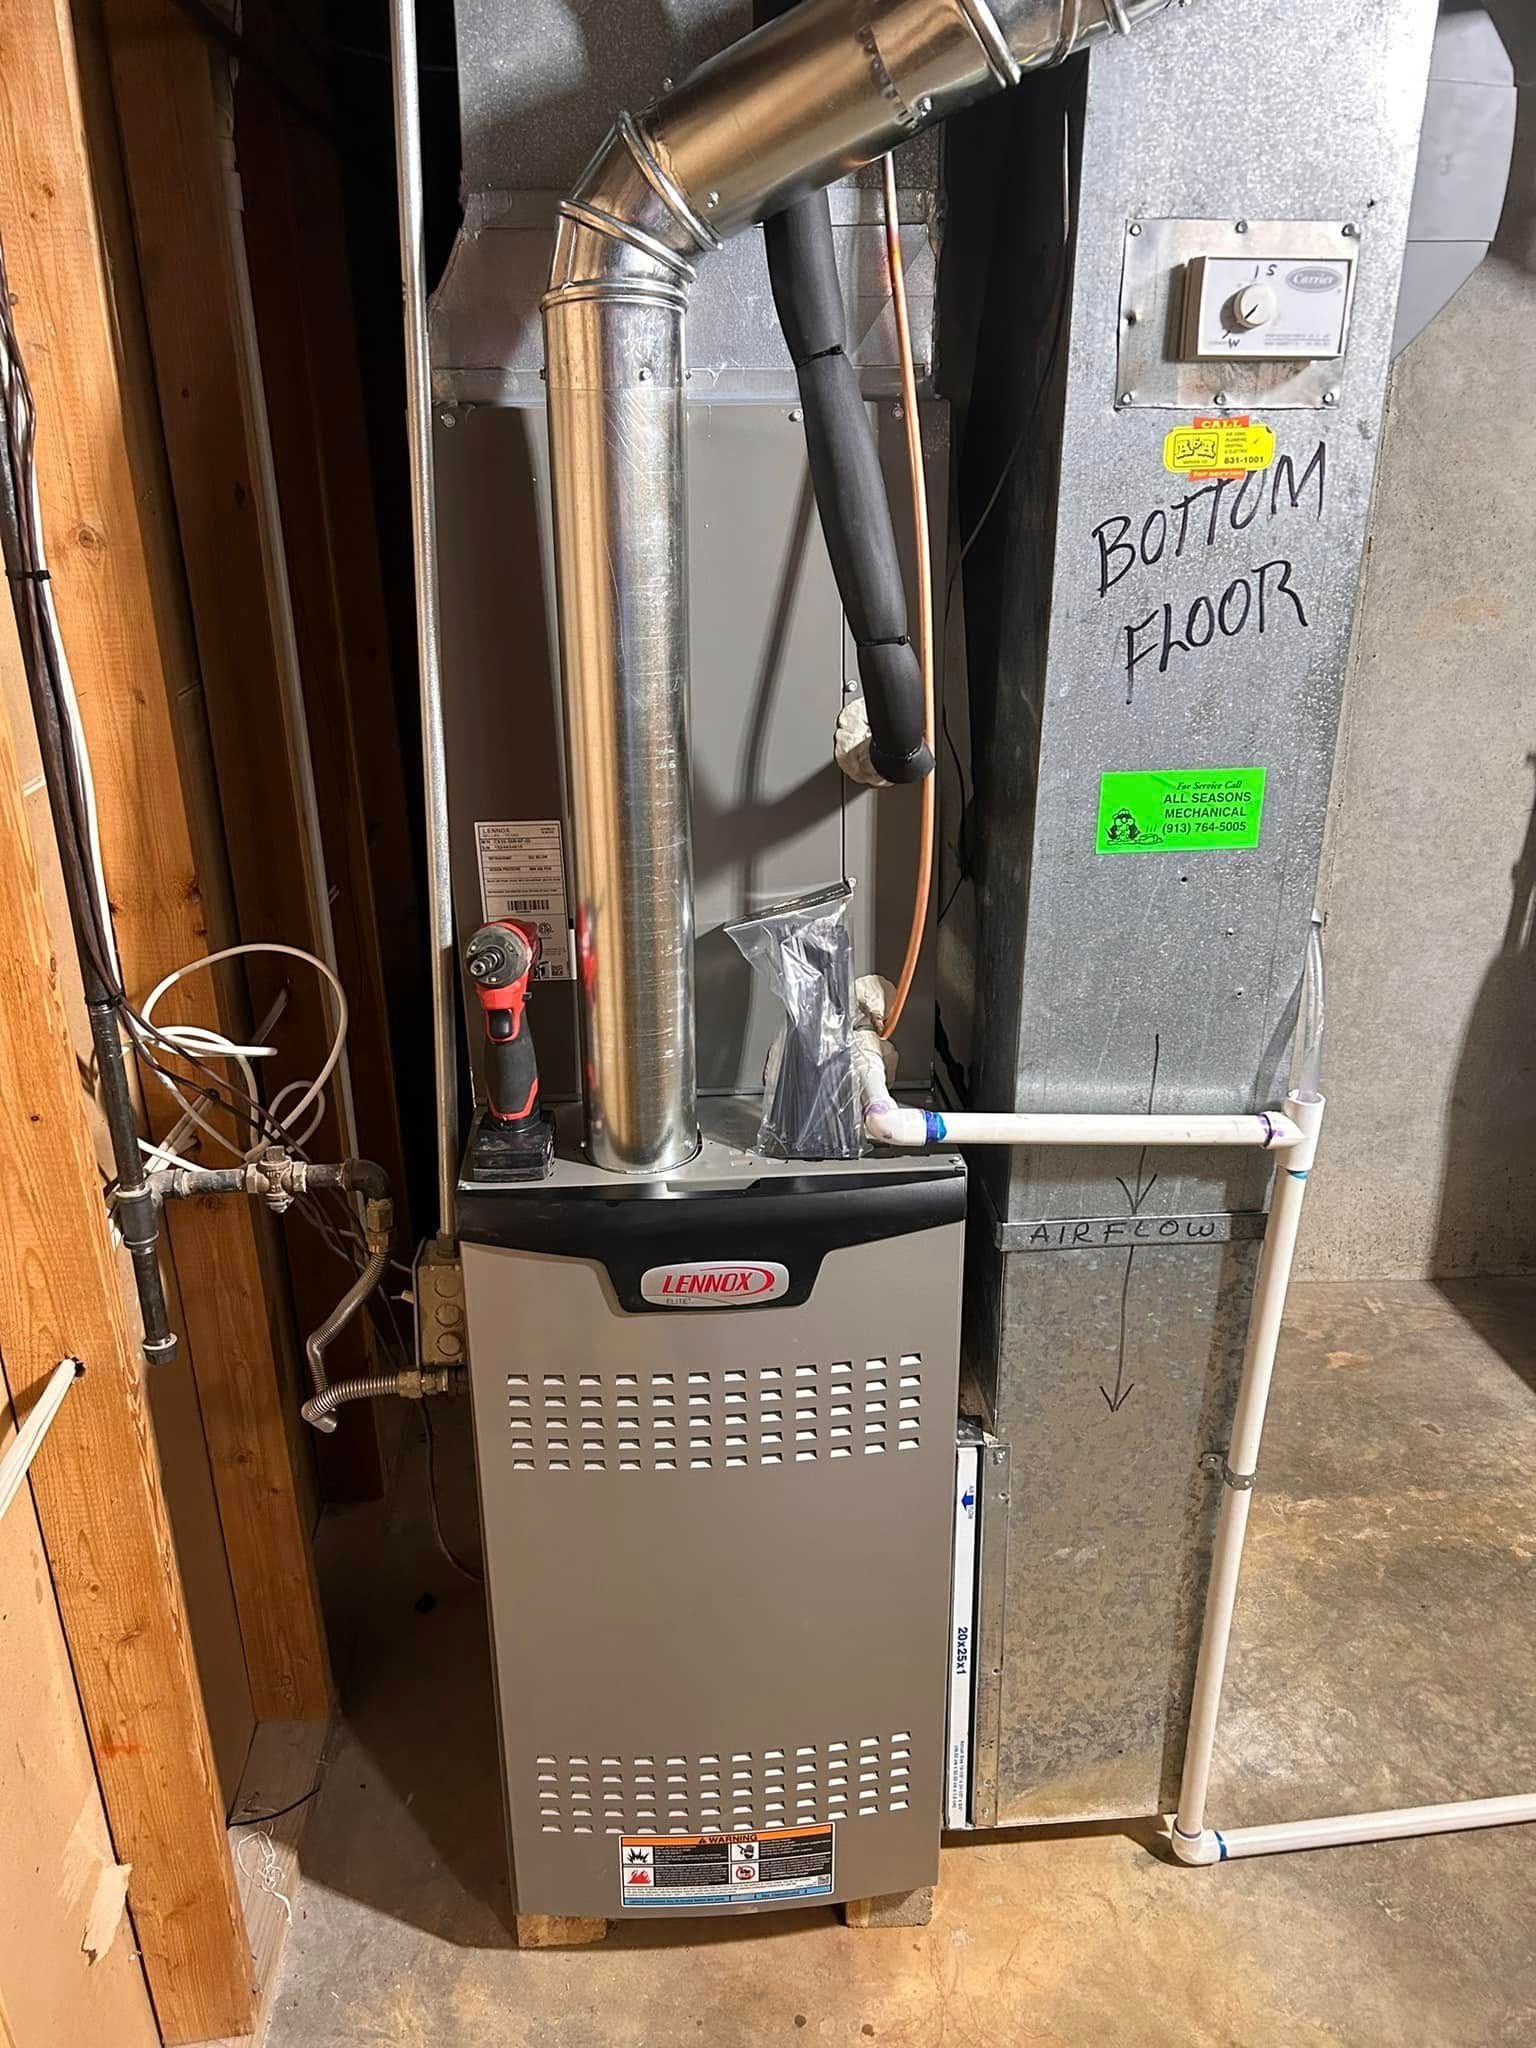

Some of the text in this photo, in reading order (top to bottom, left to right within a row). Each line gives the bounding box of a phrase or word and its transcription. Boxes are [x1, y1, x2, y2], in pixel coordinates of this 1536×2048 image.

[1201, 419, 1242, 429] CALL
[1224, 456, 1264, 465] 831-1001
[1091, 440, 1327, 599] BOTTOM
[1123, 559, 1309, 706] FLOOR
[1176, 780, 1243, 791] For Service Call
[1163, 791, 1252, 804] ALL SEASONS
[1164, 806, 1247, 819] MECHANICAL
[1161, 821, 1247, 835] (913) 764-5005
[662, 1272, 753, 1294] LENNOX
[956, 1626, 969, 1675] 20x25x1
[709, 1834, 758, 1844] WARNING
